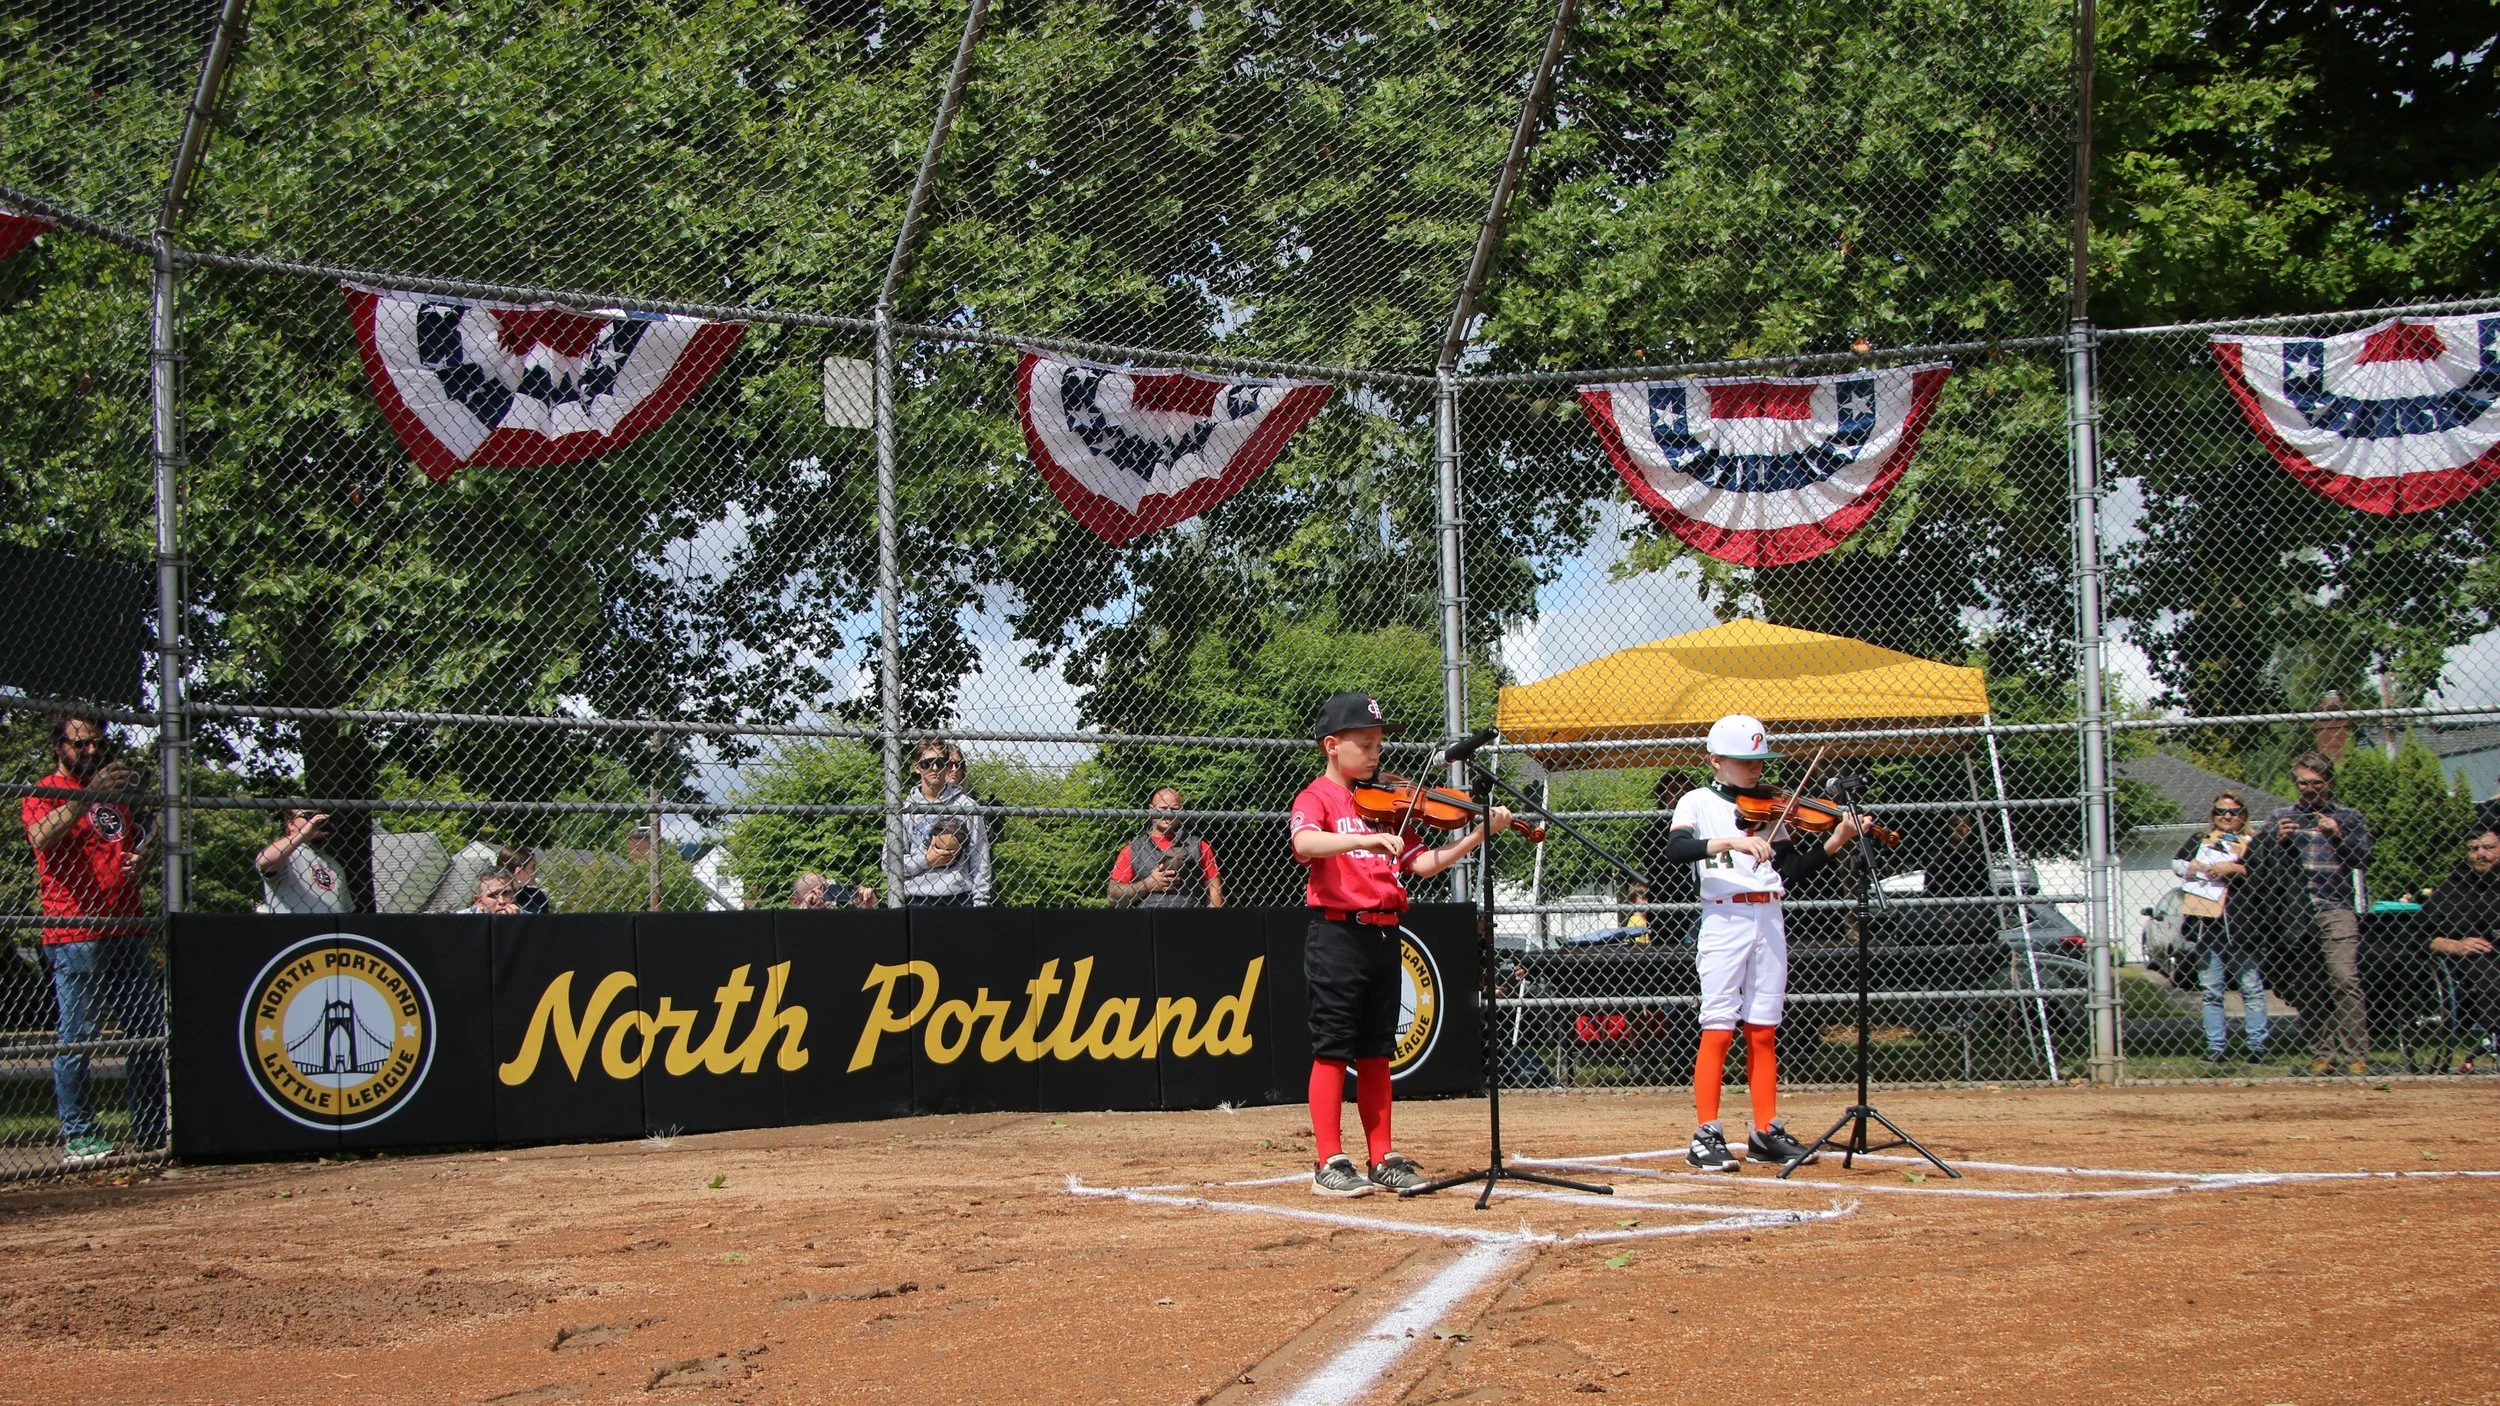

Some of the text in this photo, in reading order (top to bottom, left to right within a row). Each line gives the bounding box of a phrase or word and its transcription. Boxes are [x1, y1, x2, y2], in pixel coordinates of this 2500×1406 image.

[259, 952, 418, 1020] NORTH PORTLAND
[1400, 942, 1431, 988] LAND
[499, 955, 1265, 1086] North Portland
[264, 1050, 415, 1108] LITTLE LEAGUE
